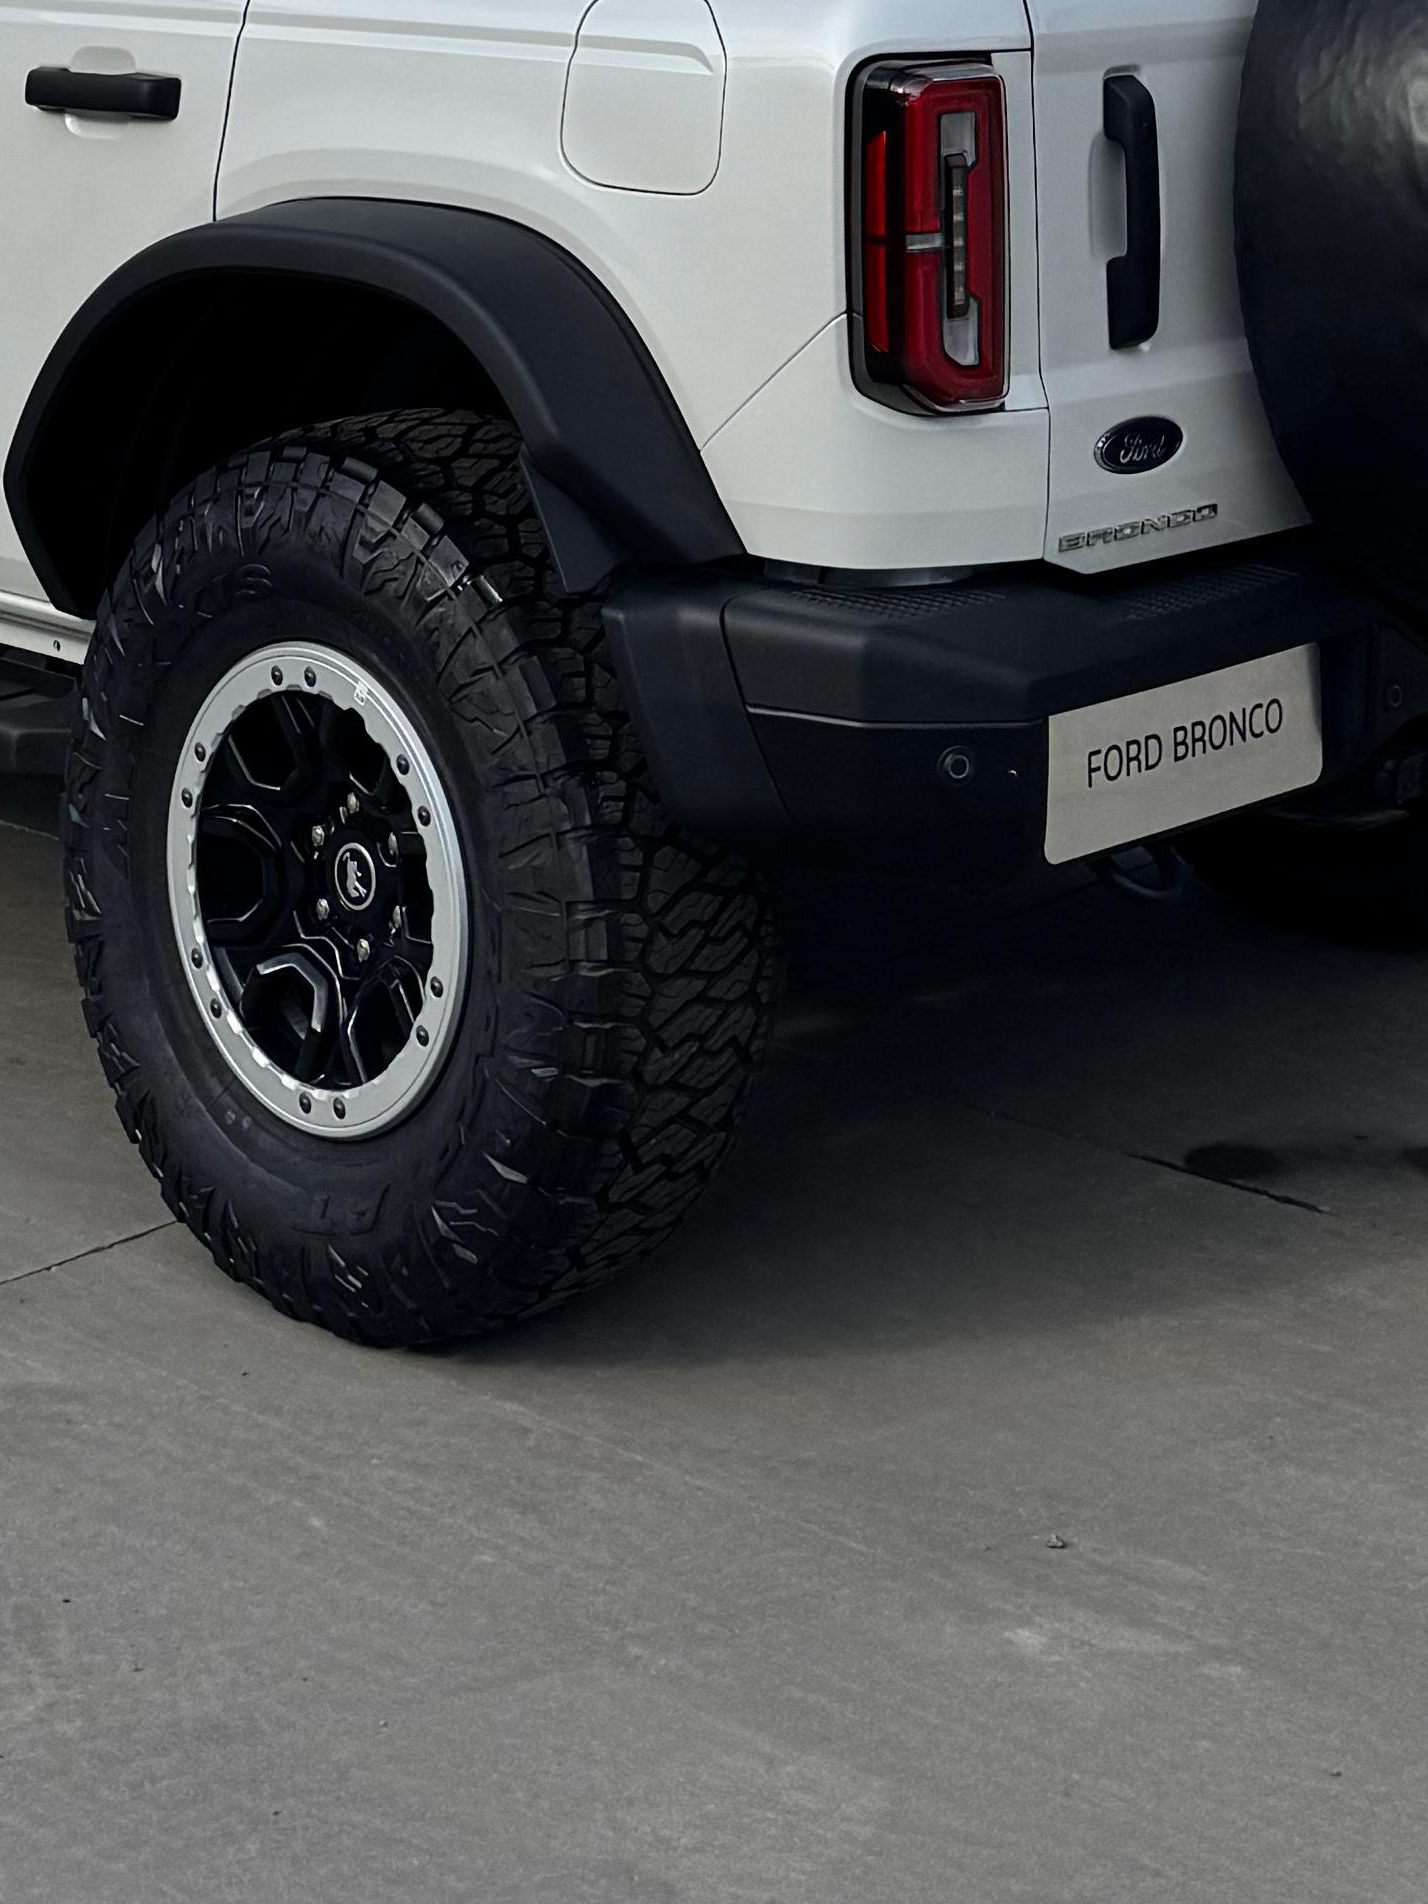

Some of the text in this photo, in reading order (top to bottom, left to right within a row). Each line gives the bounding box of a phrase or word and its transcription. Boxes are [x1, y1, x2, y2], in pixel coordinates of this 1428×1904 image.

[1119, 434, 1166, 464] Ford
[1087, 698, 1283, 788] FORD BRONCO
